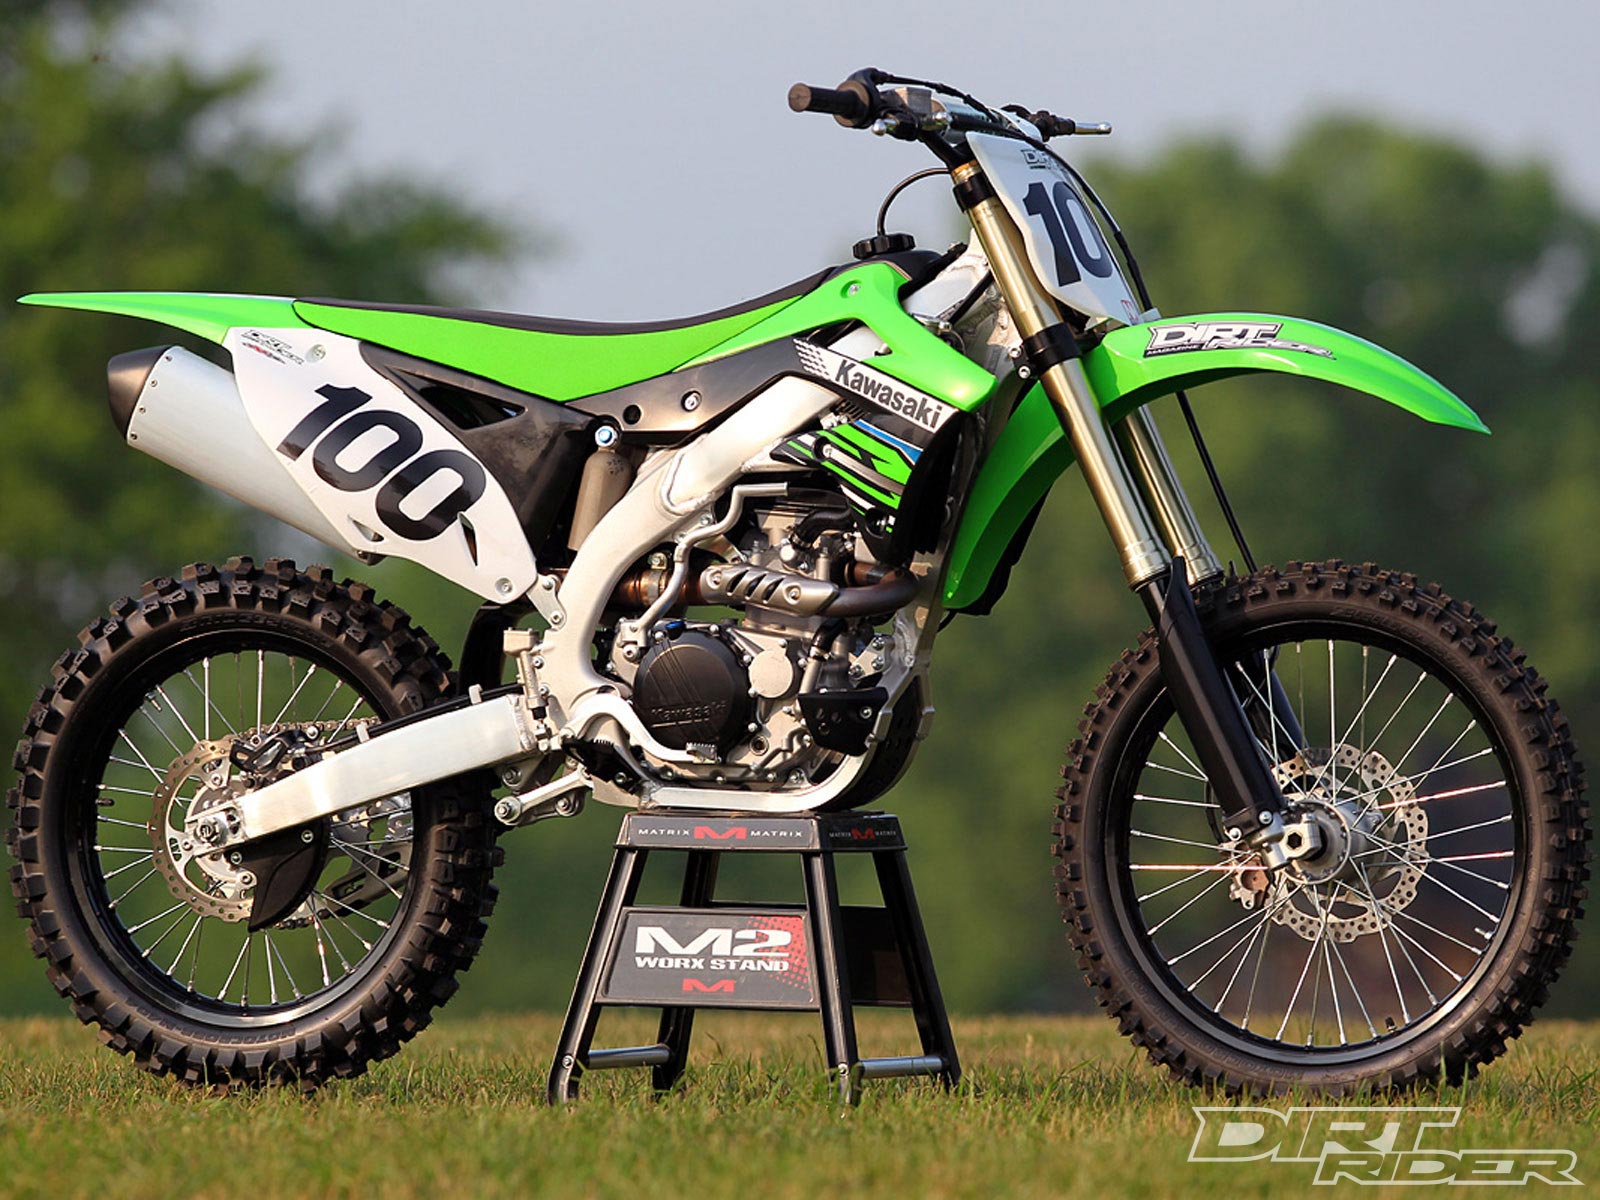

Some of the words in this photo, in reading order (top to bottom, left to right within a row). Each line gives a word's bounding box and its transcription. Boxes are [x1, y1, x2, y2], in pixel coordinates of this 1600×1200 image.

[1022, 181, 1113, 287] 10
[1146, 321, 1283, 351] DIRT
[835, 359, 943, 430] Kawasaki
[276, 383, 487, 541] 100
[638, 828, 690, 836] MATRIX
[750, 830, 803, 838] MATRIX
[635, 926, 792, 957] M2
[635, 956, 705, 969] WORX
[710, 958, 790, 972] STAND
